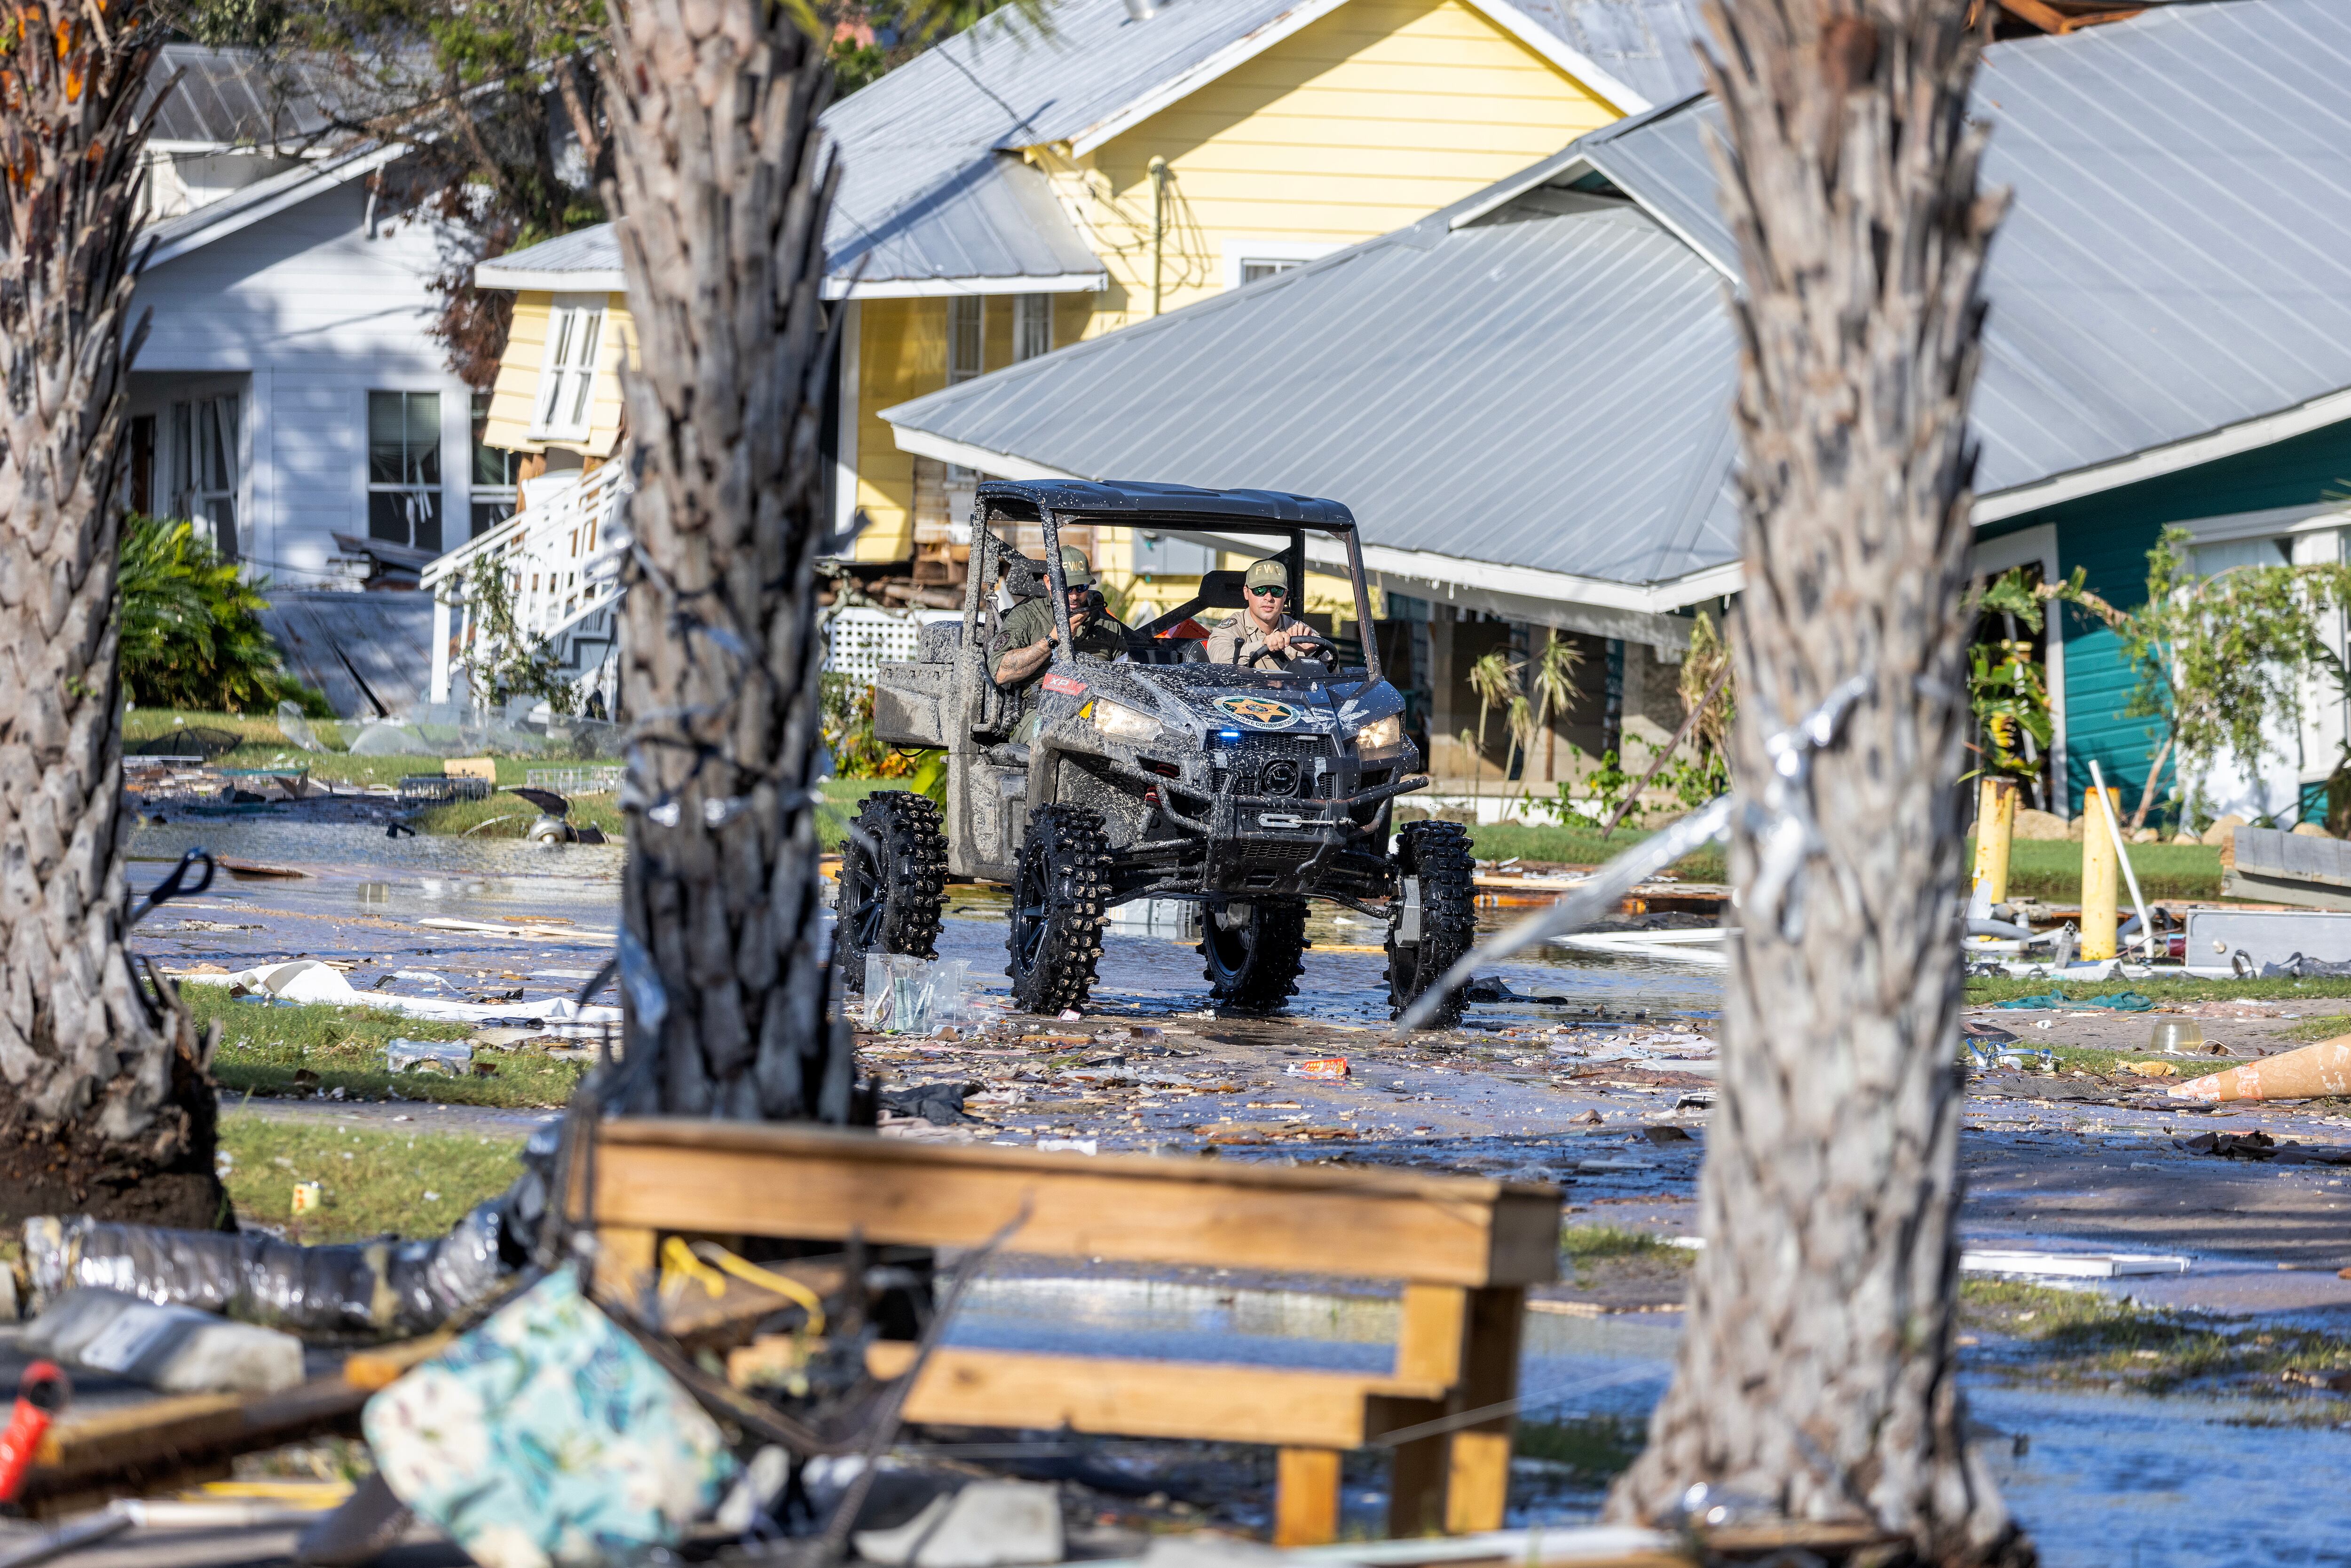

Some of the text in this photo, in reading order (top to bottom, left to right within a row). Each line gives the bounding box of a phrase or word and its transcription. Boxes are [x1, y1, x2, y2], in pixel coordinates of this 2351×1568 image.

[1062, 560, 1084, 572] FWC
[1255, 564, 1281, 575] FWC
[1049, 677, 1069, 686] XP
[1231, 713, 1255, 725] WILDLIFE
[1256, 720, 1292, 728] CONSERVATION
